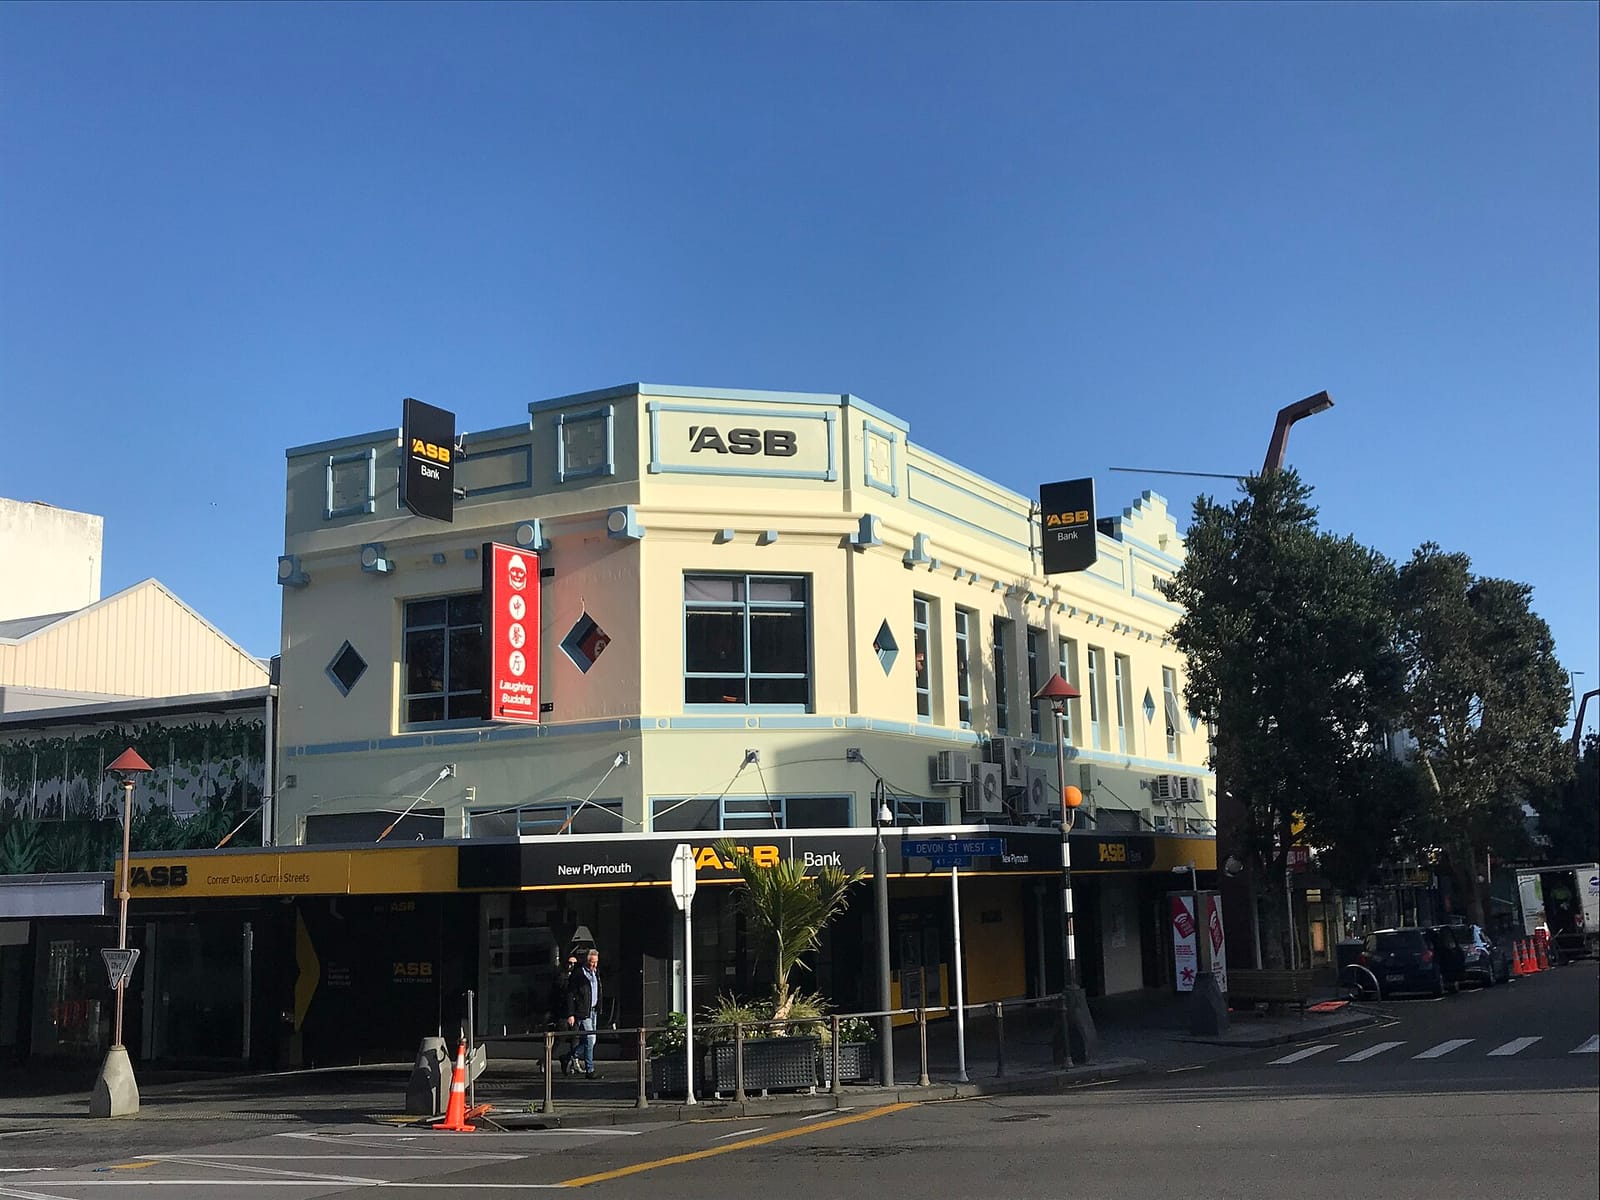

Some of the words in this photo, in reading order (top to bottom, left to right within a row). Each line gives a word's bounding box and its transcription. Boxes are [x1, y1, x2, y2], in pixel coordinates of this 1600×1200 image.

[689, 425, 798, 457] ASB
[412, 438, 451, 464] ASB
[420, 464, 440, 481] Bank
[1047, 511, 1088, 527] ASB
[1058, 531, 1078, 542] Bank
[499, 679, 534, 695] Laughing
[501, 692, 532, 706] Buddha
[916, 843, 943, 854] DEVON
[948, 843, 958, 853] ST
[962, 842, 985, 853] WEST
[803, 851, 842, 867] Bank
[557, 863, 581, 876] New
[583, 862, 632, 877] Plymouth
[207, 875, 230, 885] Corner
[231, 874, 253, 884] Devon
[254, 874, 260, 883] &
[283, 872, 310, 883] Streets
